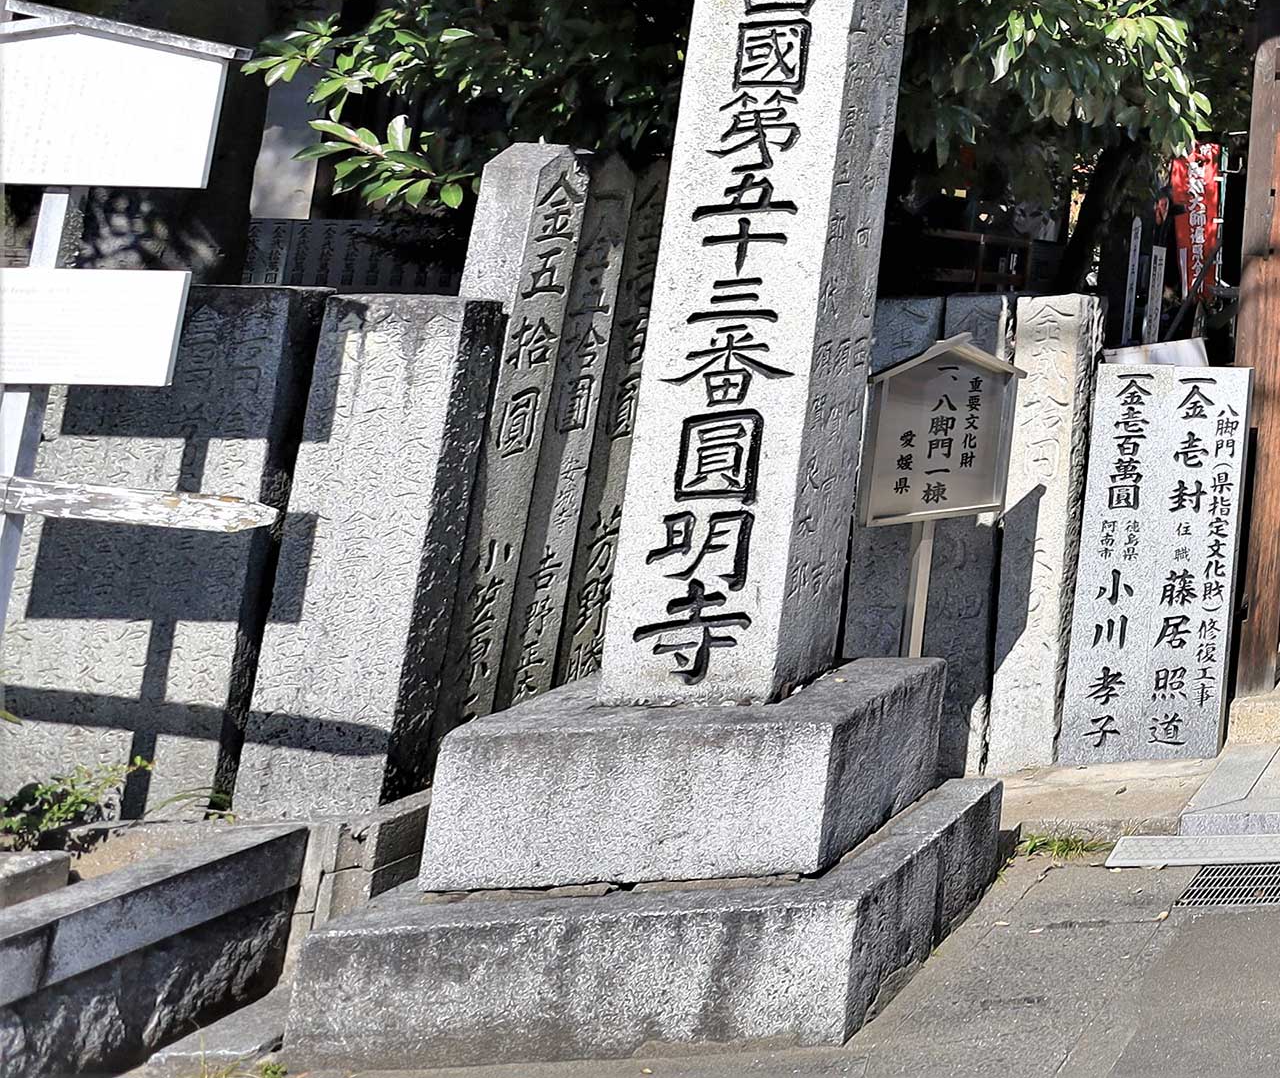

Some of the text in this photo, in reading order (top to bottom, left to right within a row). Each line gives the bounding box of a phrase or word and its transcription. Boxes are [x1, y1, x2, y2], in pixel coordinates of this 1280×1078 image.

[959, 377, 983, 468] 重要文化財
[893, 430, 916, 494] 愛媛県
[1100, 519, 1117, 559] 阿南市
[1123, 519, 1140, 560] 徳島県
[1174, 522, 1192, 561] 住職
[1083, 568, 1134, 749] 小川孝子
[1147, 571, 1198, 746] 藤居照道
